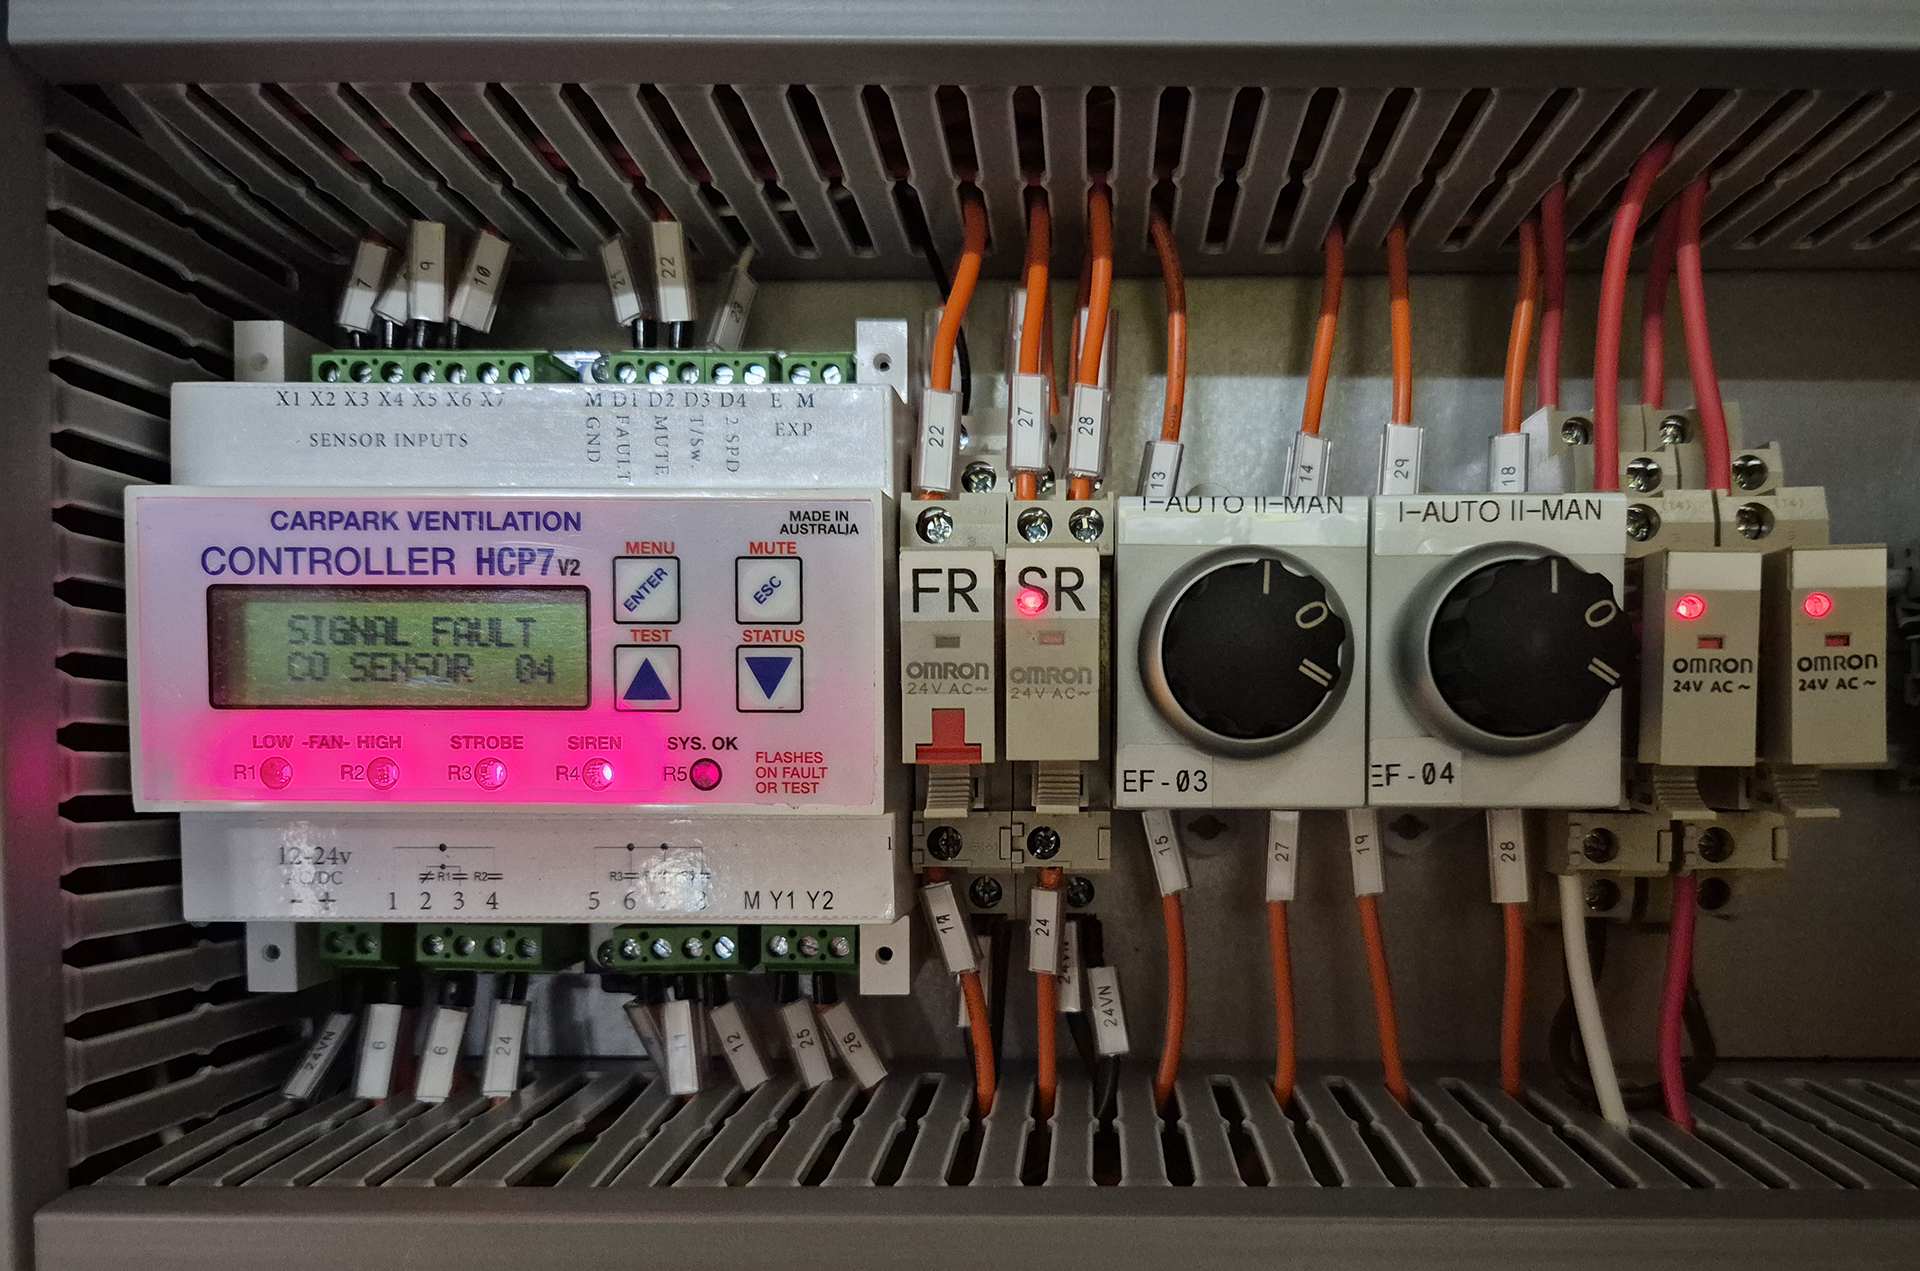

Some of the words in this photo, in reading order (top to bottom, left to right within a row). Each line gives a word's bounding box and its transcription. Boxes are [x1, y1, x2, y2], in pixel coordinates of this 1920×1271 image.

[660, 256, 677, 279] 22
[356, 277, 372, 288] 7
[276, 390, 300, 407] X1
[310, 390, 336, 407] X2
[345, 390, 370, 407] X3
[379, 390, 404, 407] X4
[413, 390, 438, 407] X5
[446, 390, 472, 407] X6
[480, 390, 505, 407] X7
[585, 392, 603, 408] M
[613, 392, 638, 408] D1
[648, 392, 674, 408] D2
[684, 392, 710, 408] D3
[720, 392, 746, 408] D4
[771, 393, 782, 408] E
[796, 393, 815, 408] M
[726, 416, 738, 426] 2
[1018, 406, 1034, 428] 27
[775, 422, 813, 436] EXP
[1078, 416, 1094, 436] 28
[310, 432, 388, 448] SENSOR
[394, 432, 468, 448] INPUTS
[586, 416, 600, 463] GND
[928, 425, 944, 448] 22
[616, 416, 631, 482] FAULT
[654, 416, 670, 476] MUTE
[726, 434, 740, 473] SPD
[1300, 464, 1314, 482] 14
[1394, 458, 1409, 480] 29
[1501, 466, 1516, 486] 18
[1150, 470, 1166, 490] 13
[789, 510, 832, 522] MADE
[835, 510, 849, 522] IN
[1399, 500, 1500, 523] I-AUTO
[1510, 498, 1602, 521] II-MAN
[270, 510, 400, 532] CARPARK
[407, 510, 582, 532] VENTILATION
[780, 524, 859, 536] AUSTRALIA
[625, 541, 676, 555] MENU
[749, 541, 797, 555] MUTE
[201, 546, 456, 577] CONTROLLER
[476, 547, 555, 577] HCP7
[558, 558, 581, 577] V2
[623, 567, 668, 613] ENTER
[753, 575, 782, 605] ESC
[912, 568, 980, 613] FR
[1017, 566, 1086, 613] SR
[286, 614, 410, 647] SIGNAL
[431, 616, 538, 649] FAULT
[630, 629, 672, 642] TEST
[742, 629, 806, 643] STATUS
[286, 651, 330, 683] CO
[349, 651, 476, 684] SENSOR
[514, 654, 555, 685] 04
[1672, 658, 1754, 674] OMRON
[1796, 654, 1878, 673] OMRON
[907, 682, 943, 695] 24V
[1010, 688, 1045, 699] 24V
[1672, 680, 1704, 693] 24V
[1798, 678, 1829, 692] 24V
[252, 734, 294, 750] LOW
[356, 734, 402, 750] HIGH
[450, 735, 524, 750] STROBE
[567, 736, 622, 751] SIREN
[667, 736, 707, 751] SYS.
[712, 736, 739, 751] OK
[756, 752, 824, 764] FLASHES
[233, 764, 256, 780] R1
[340, 764, 364, 781] R2
[448, 765, 472, 781] R3
[556, 766, 580, 782] R4
[664, 766, 688, 782] R5
[756, 766, 778, 780] ON
[782, 766, 828, 780] FAULT
[756, 782, 778, 795] OR
[781, 782, 820, 795] TEST
[1158, 834, 1171, 856] 15
[1274, 842, 1289, 862] 27
[1354, 834, 1370, 855] 19
[1500, 840, 1516, 863] 28
[610, 872, 624, 882] R3
[388, 892, 398, 910] 1
[420, 892, 432, 910] 2
[453, 892, 465, 910] 3
[486, 892, 499, 910] 4
[588, 892, 600, 910] 5
[623, 892, 636, 910] 6
[744, 890, 760, 910] M
[770, 890, 794, 910] Y1
[807, 890, 834, 910] Y2
[1035, 918, 1050, 937] 24
[1098, 985, 1118, 1028] 24VN
[495, 1035, 514, 1056] 24
[726, 1032, 745, 1053] 12
[796, 1028, 814, 1049] 25
[843, 1032, 862, 1053] 26
[304, 1030, 336, 1071] 24VN
